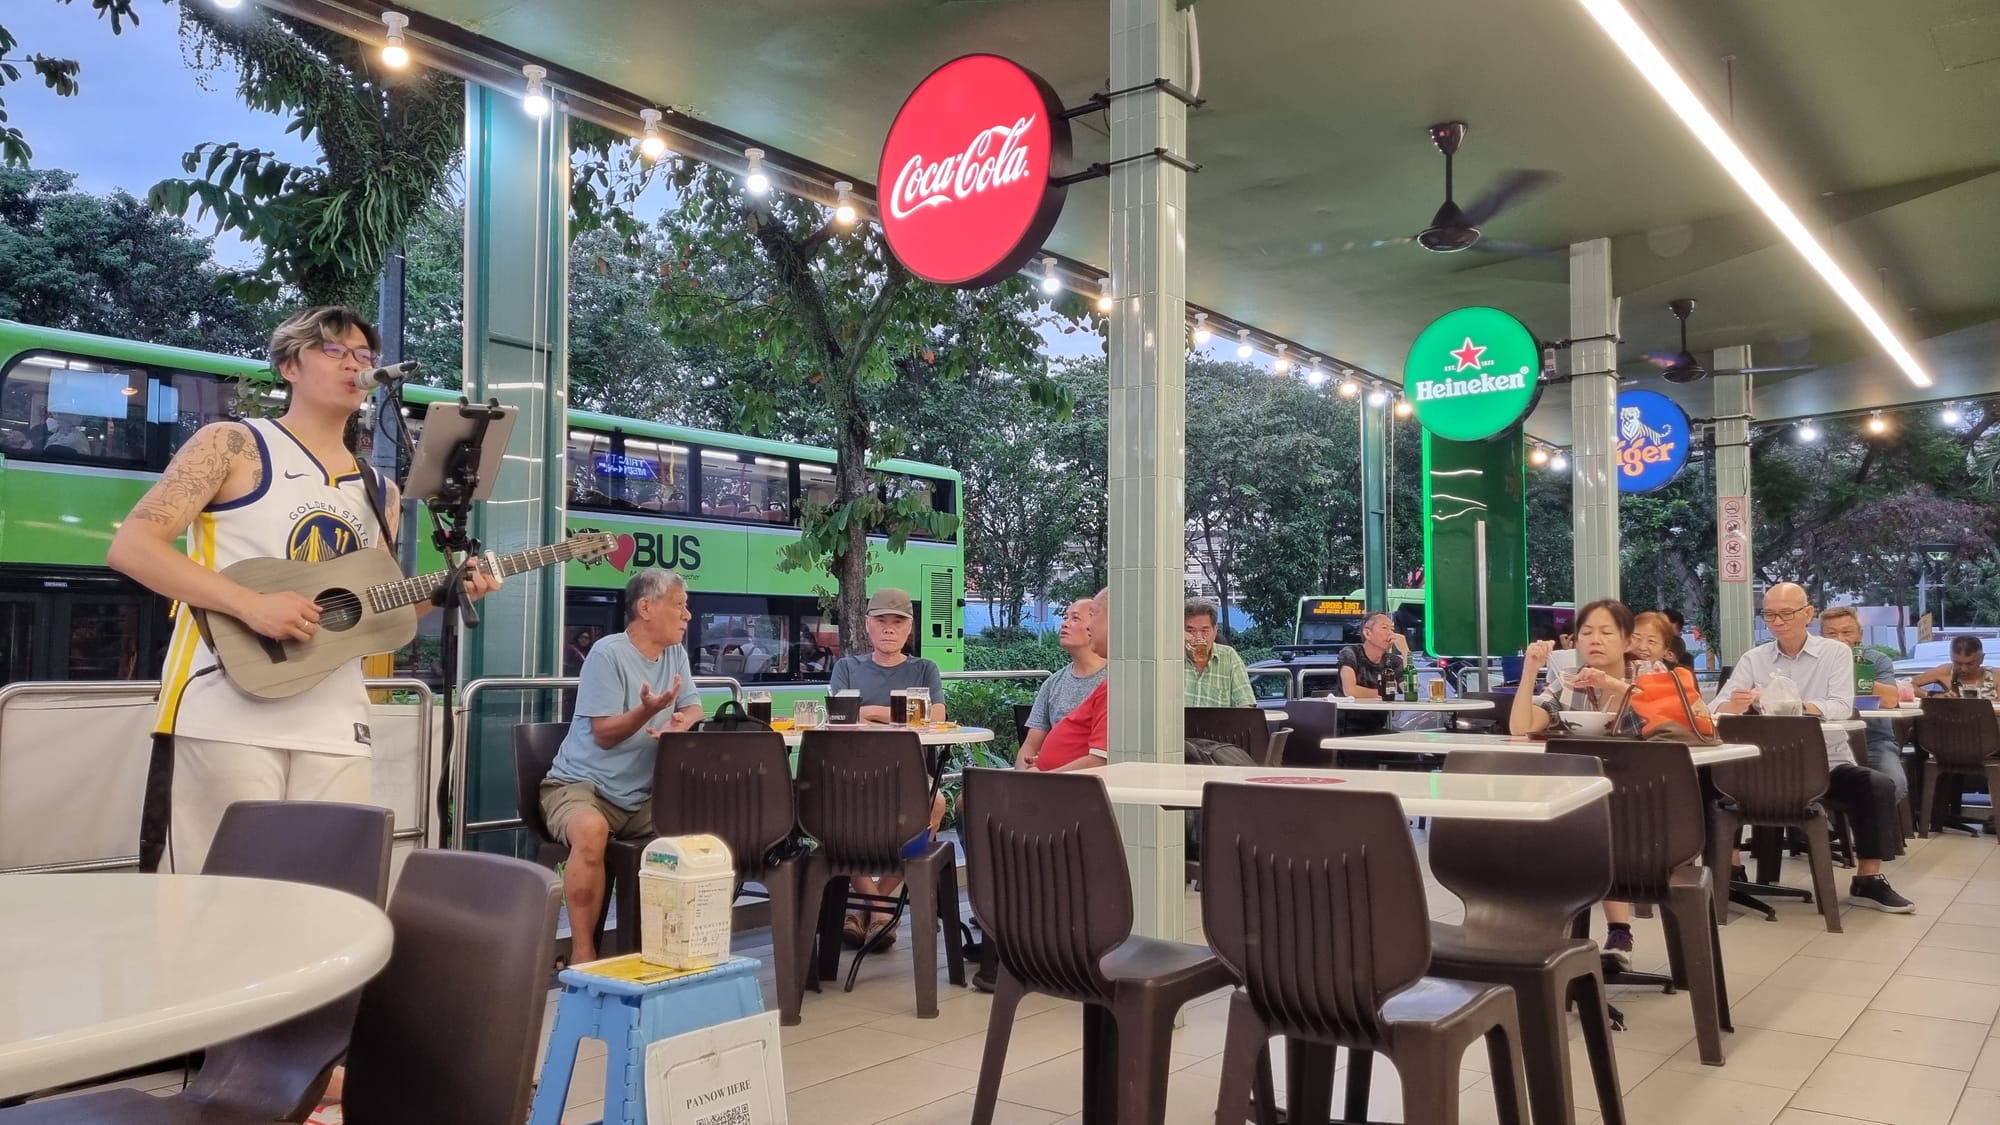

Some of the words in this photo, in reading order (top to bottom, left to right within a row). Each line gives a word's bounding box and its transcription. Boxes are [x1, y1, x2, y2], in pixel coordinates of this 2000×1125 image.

[890, 113, 1036, 219] Coca-Cola
[1616, 438, 1675, 477] iger
[288, 501, 337, 521] GOLDEN
[341, 510, 369, 549] STATE
[632, 532, 701, 571] BUS
[686, 1087, 726, 1110] PAYNOW
[727, 1080, 752, 1097] HERE
